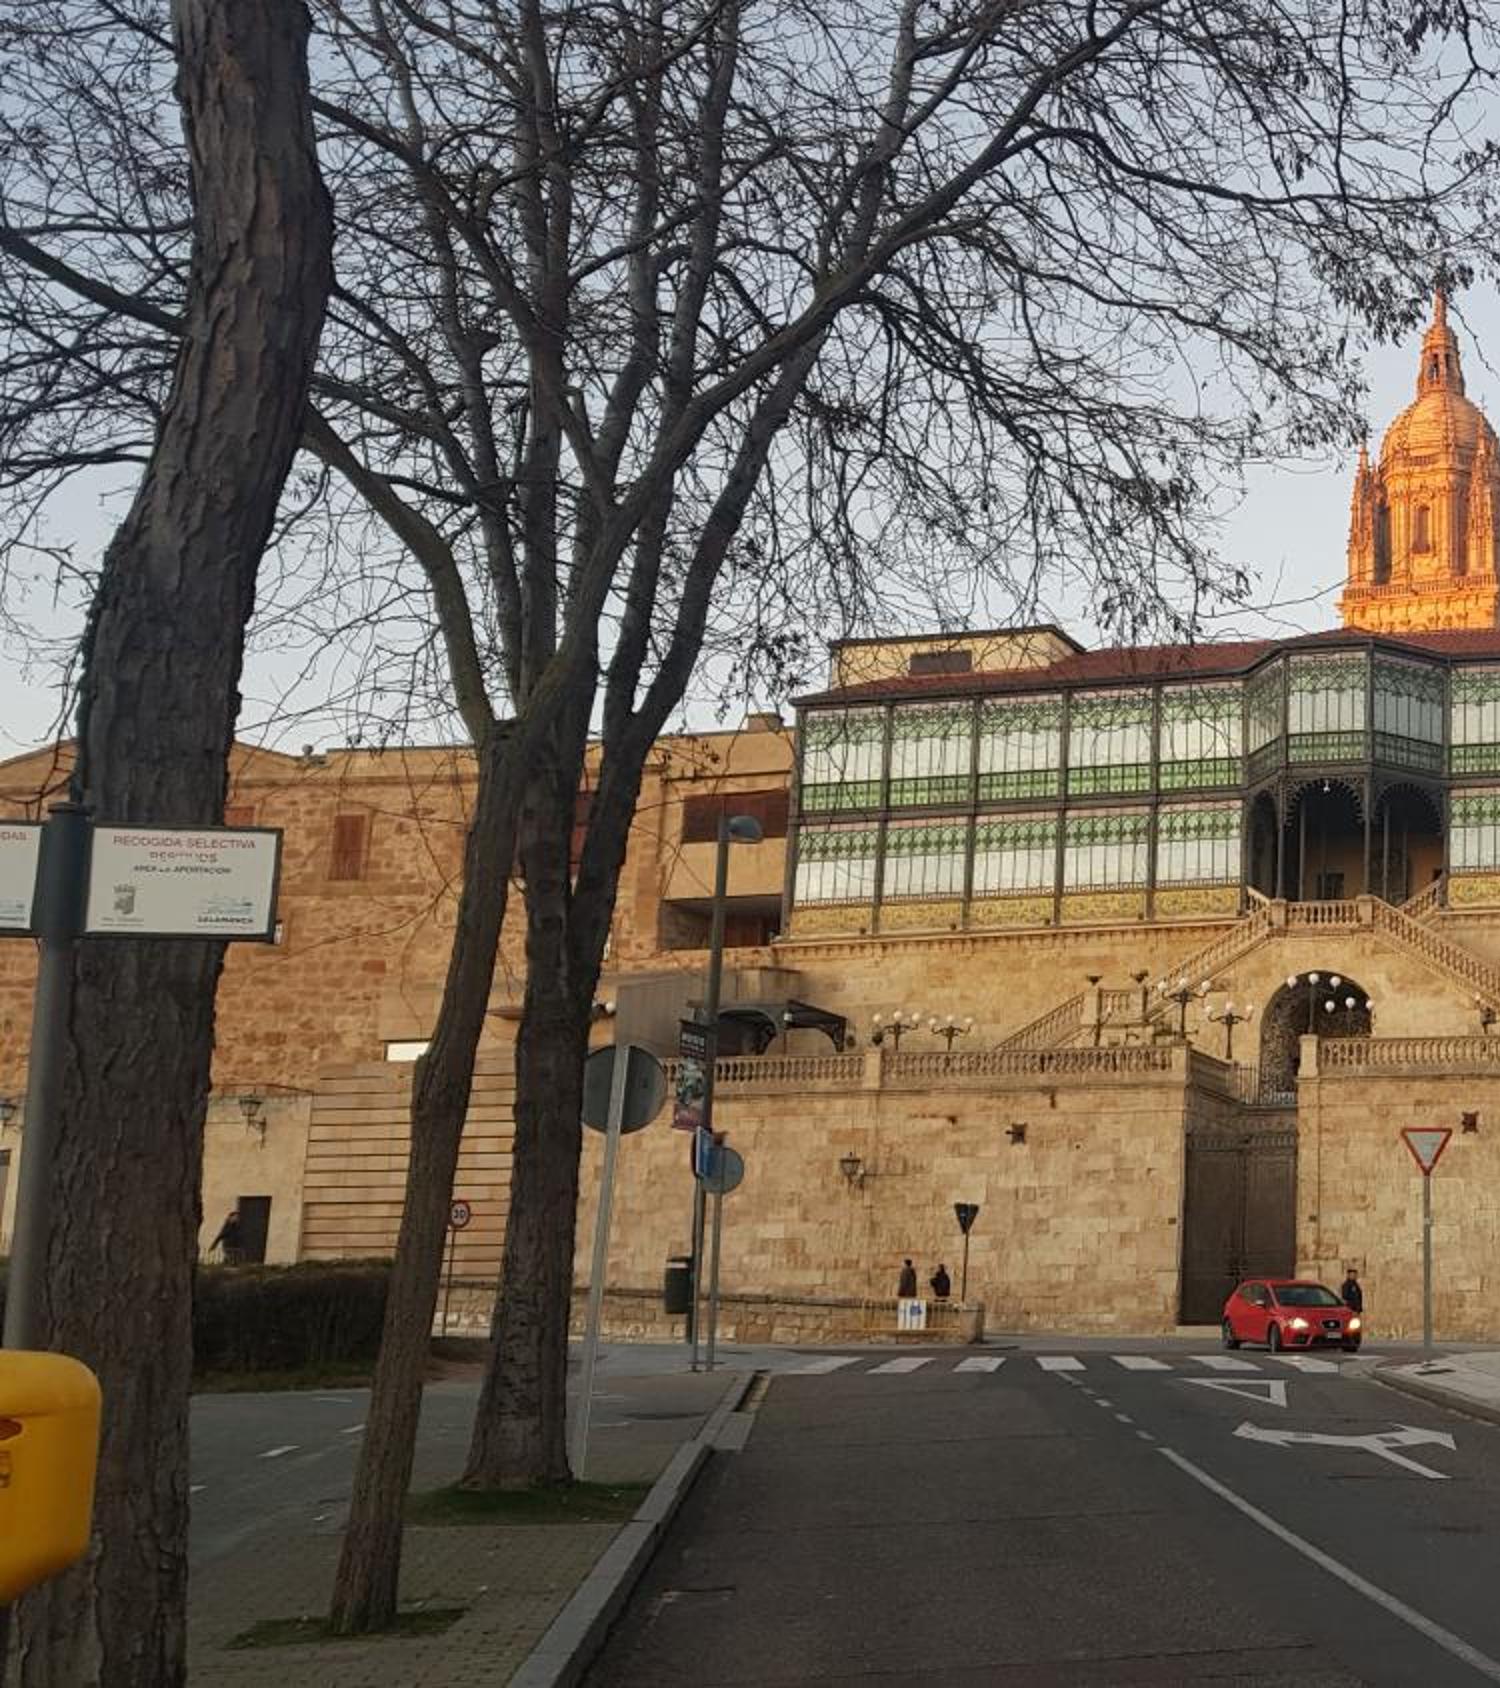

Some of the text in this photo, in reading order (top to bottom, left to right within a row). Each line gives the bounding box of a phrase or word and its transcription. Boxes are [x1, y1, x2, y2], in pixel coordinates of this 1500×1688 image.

[113, 835, 256, 849] RECOGIDA SELECTIVA
[453, 1208, 466, 1219] 30
